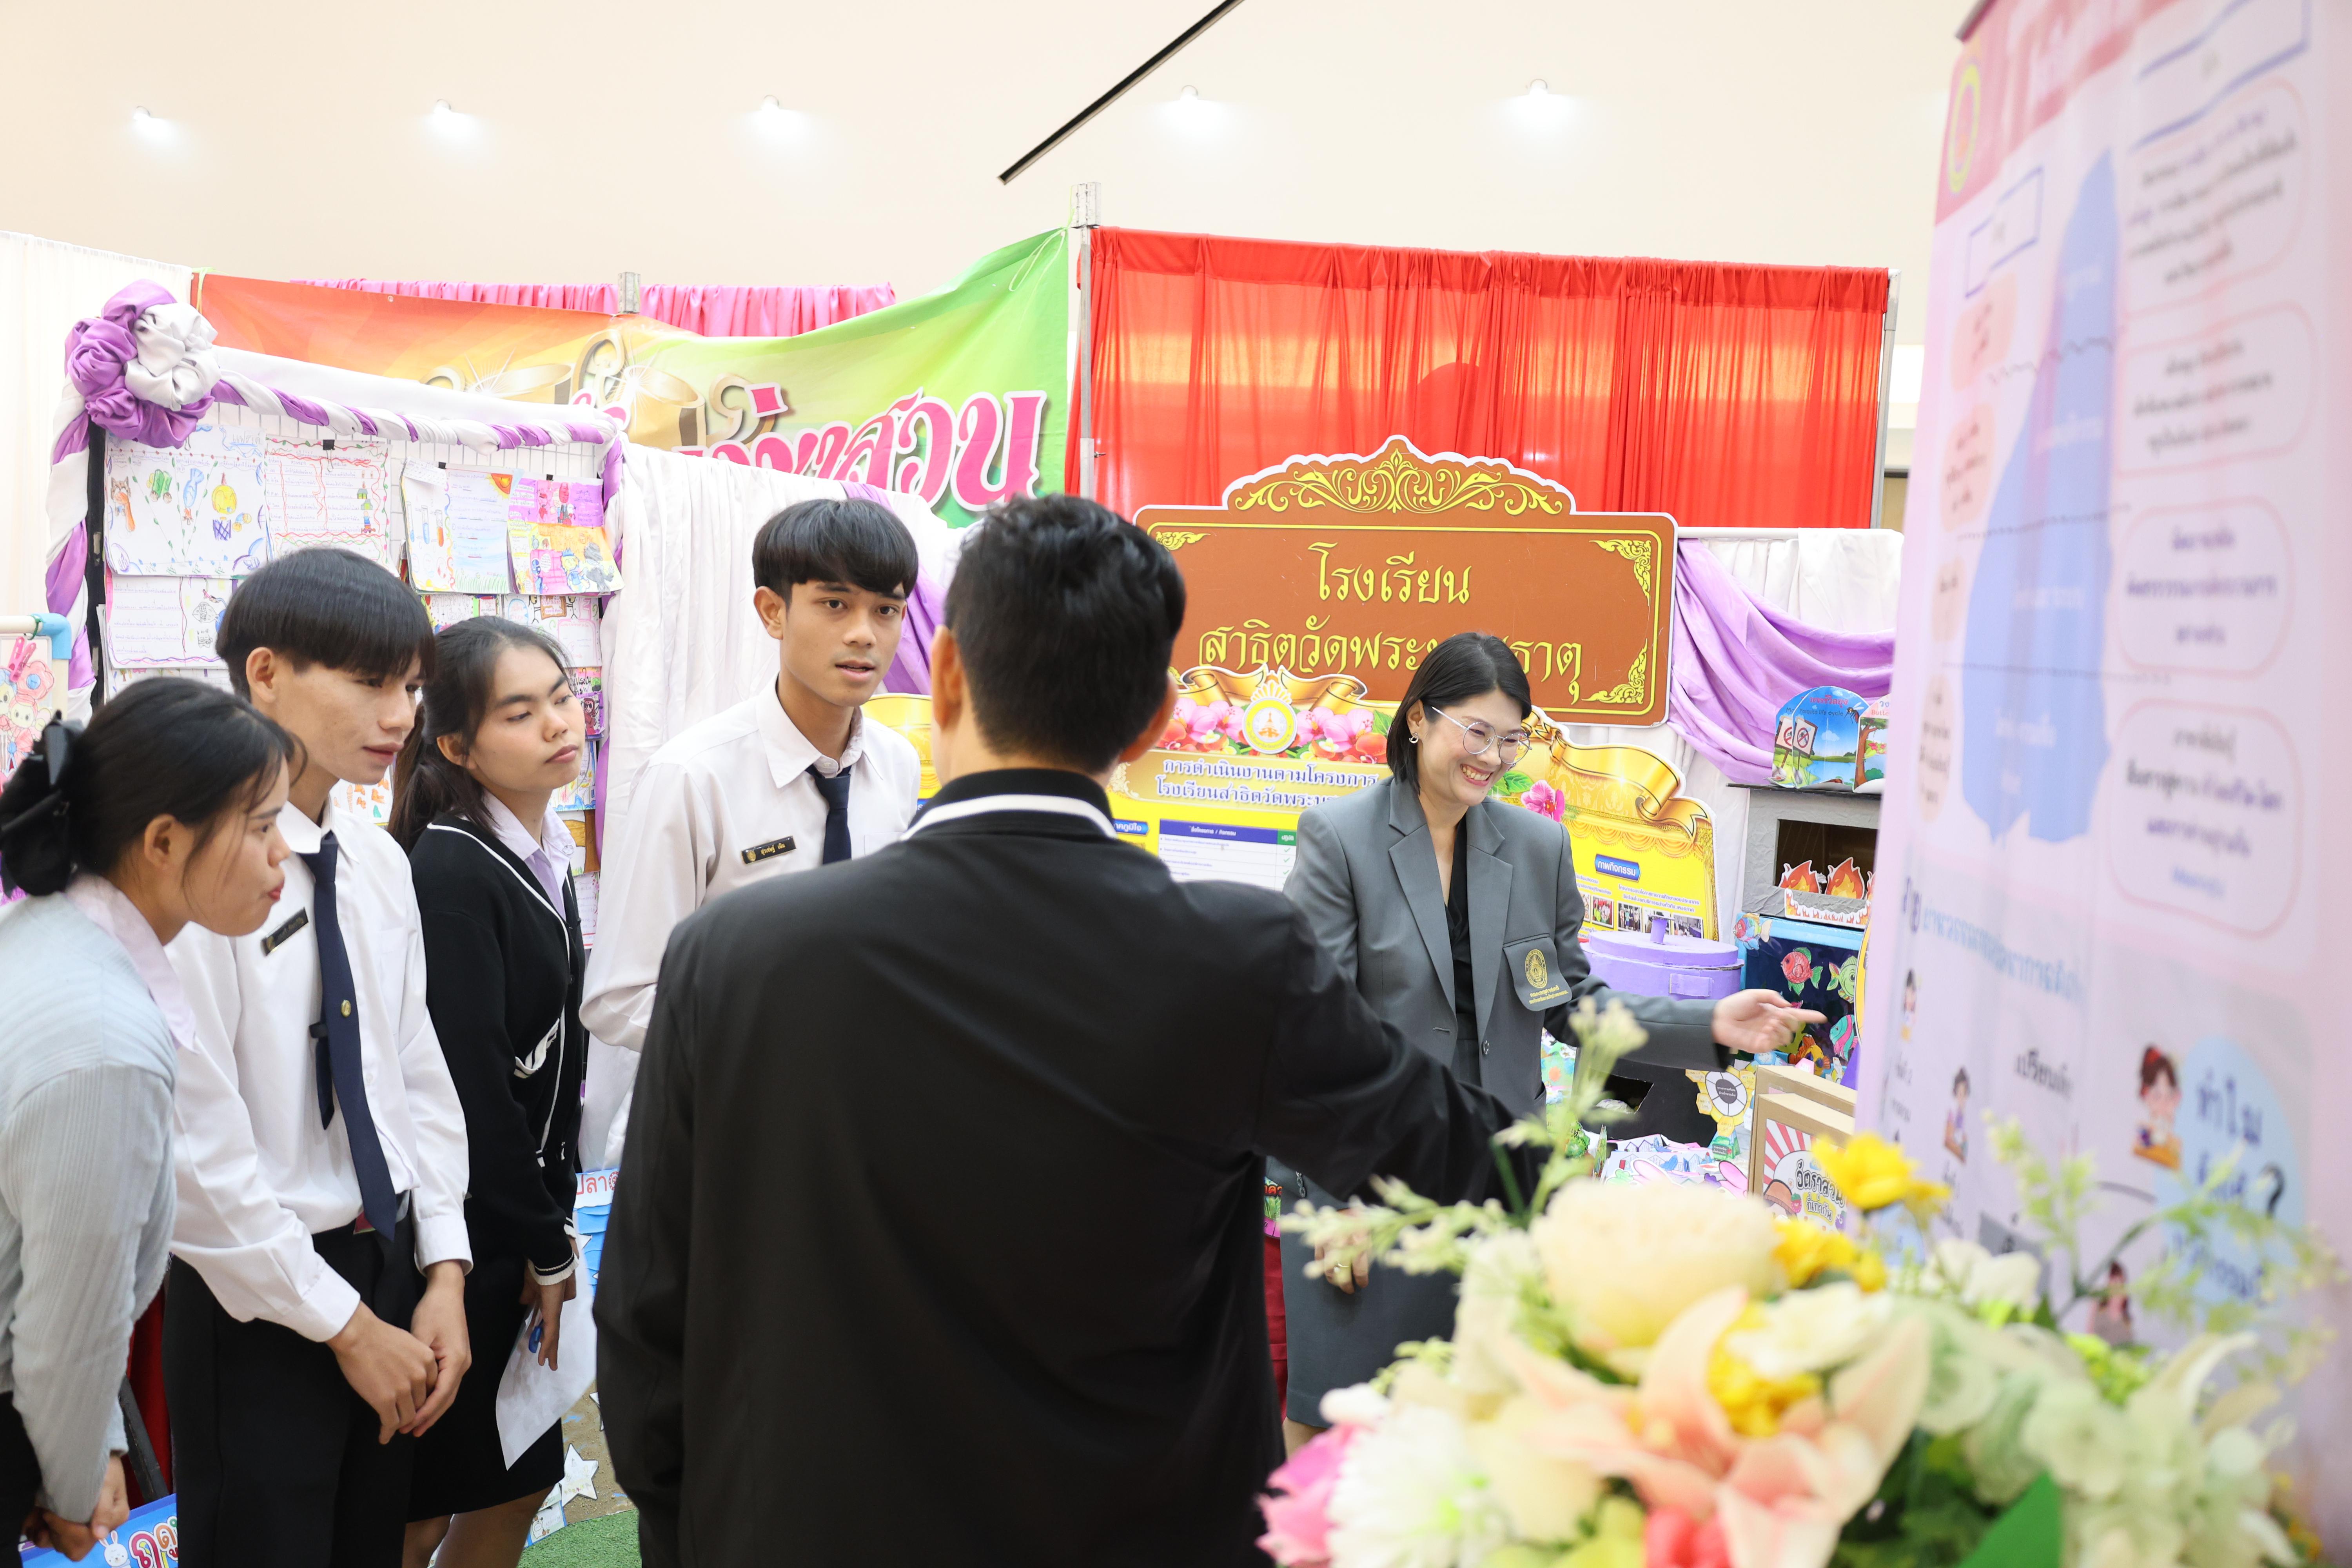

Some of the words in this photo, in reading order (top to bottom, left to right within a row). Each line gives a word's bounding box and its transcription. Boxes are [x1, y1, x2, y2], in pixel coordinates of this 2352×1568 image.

[1307, 541, 1472, 605] โรงเรียน
[1198, 615, 1582, 705] สาธิตวัดพระธาตุ
[1828, 709, 1844, 717] cycle
[1164, 759, 1378, 787] การดำเนินงานตามโครงการ
[1597, 860, 1636, 877] ภาพกิจกรรม
